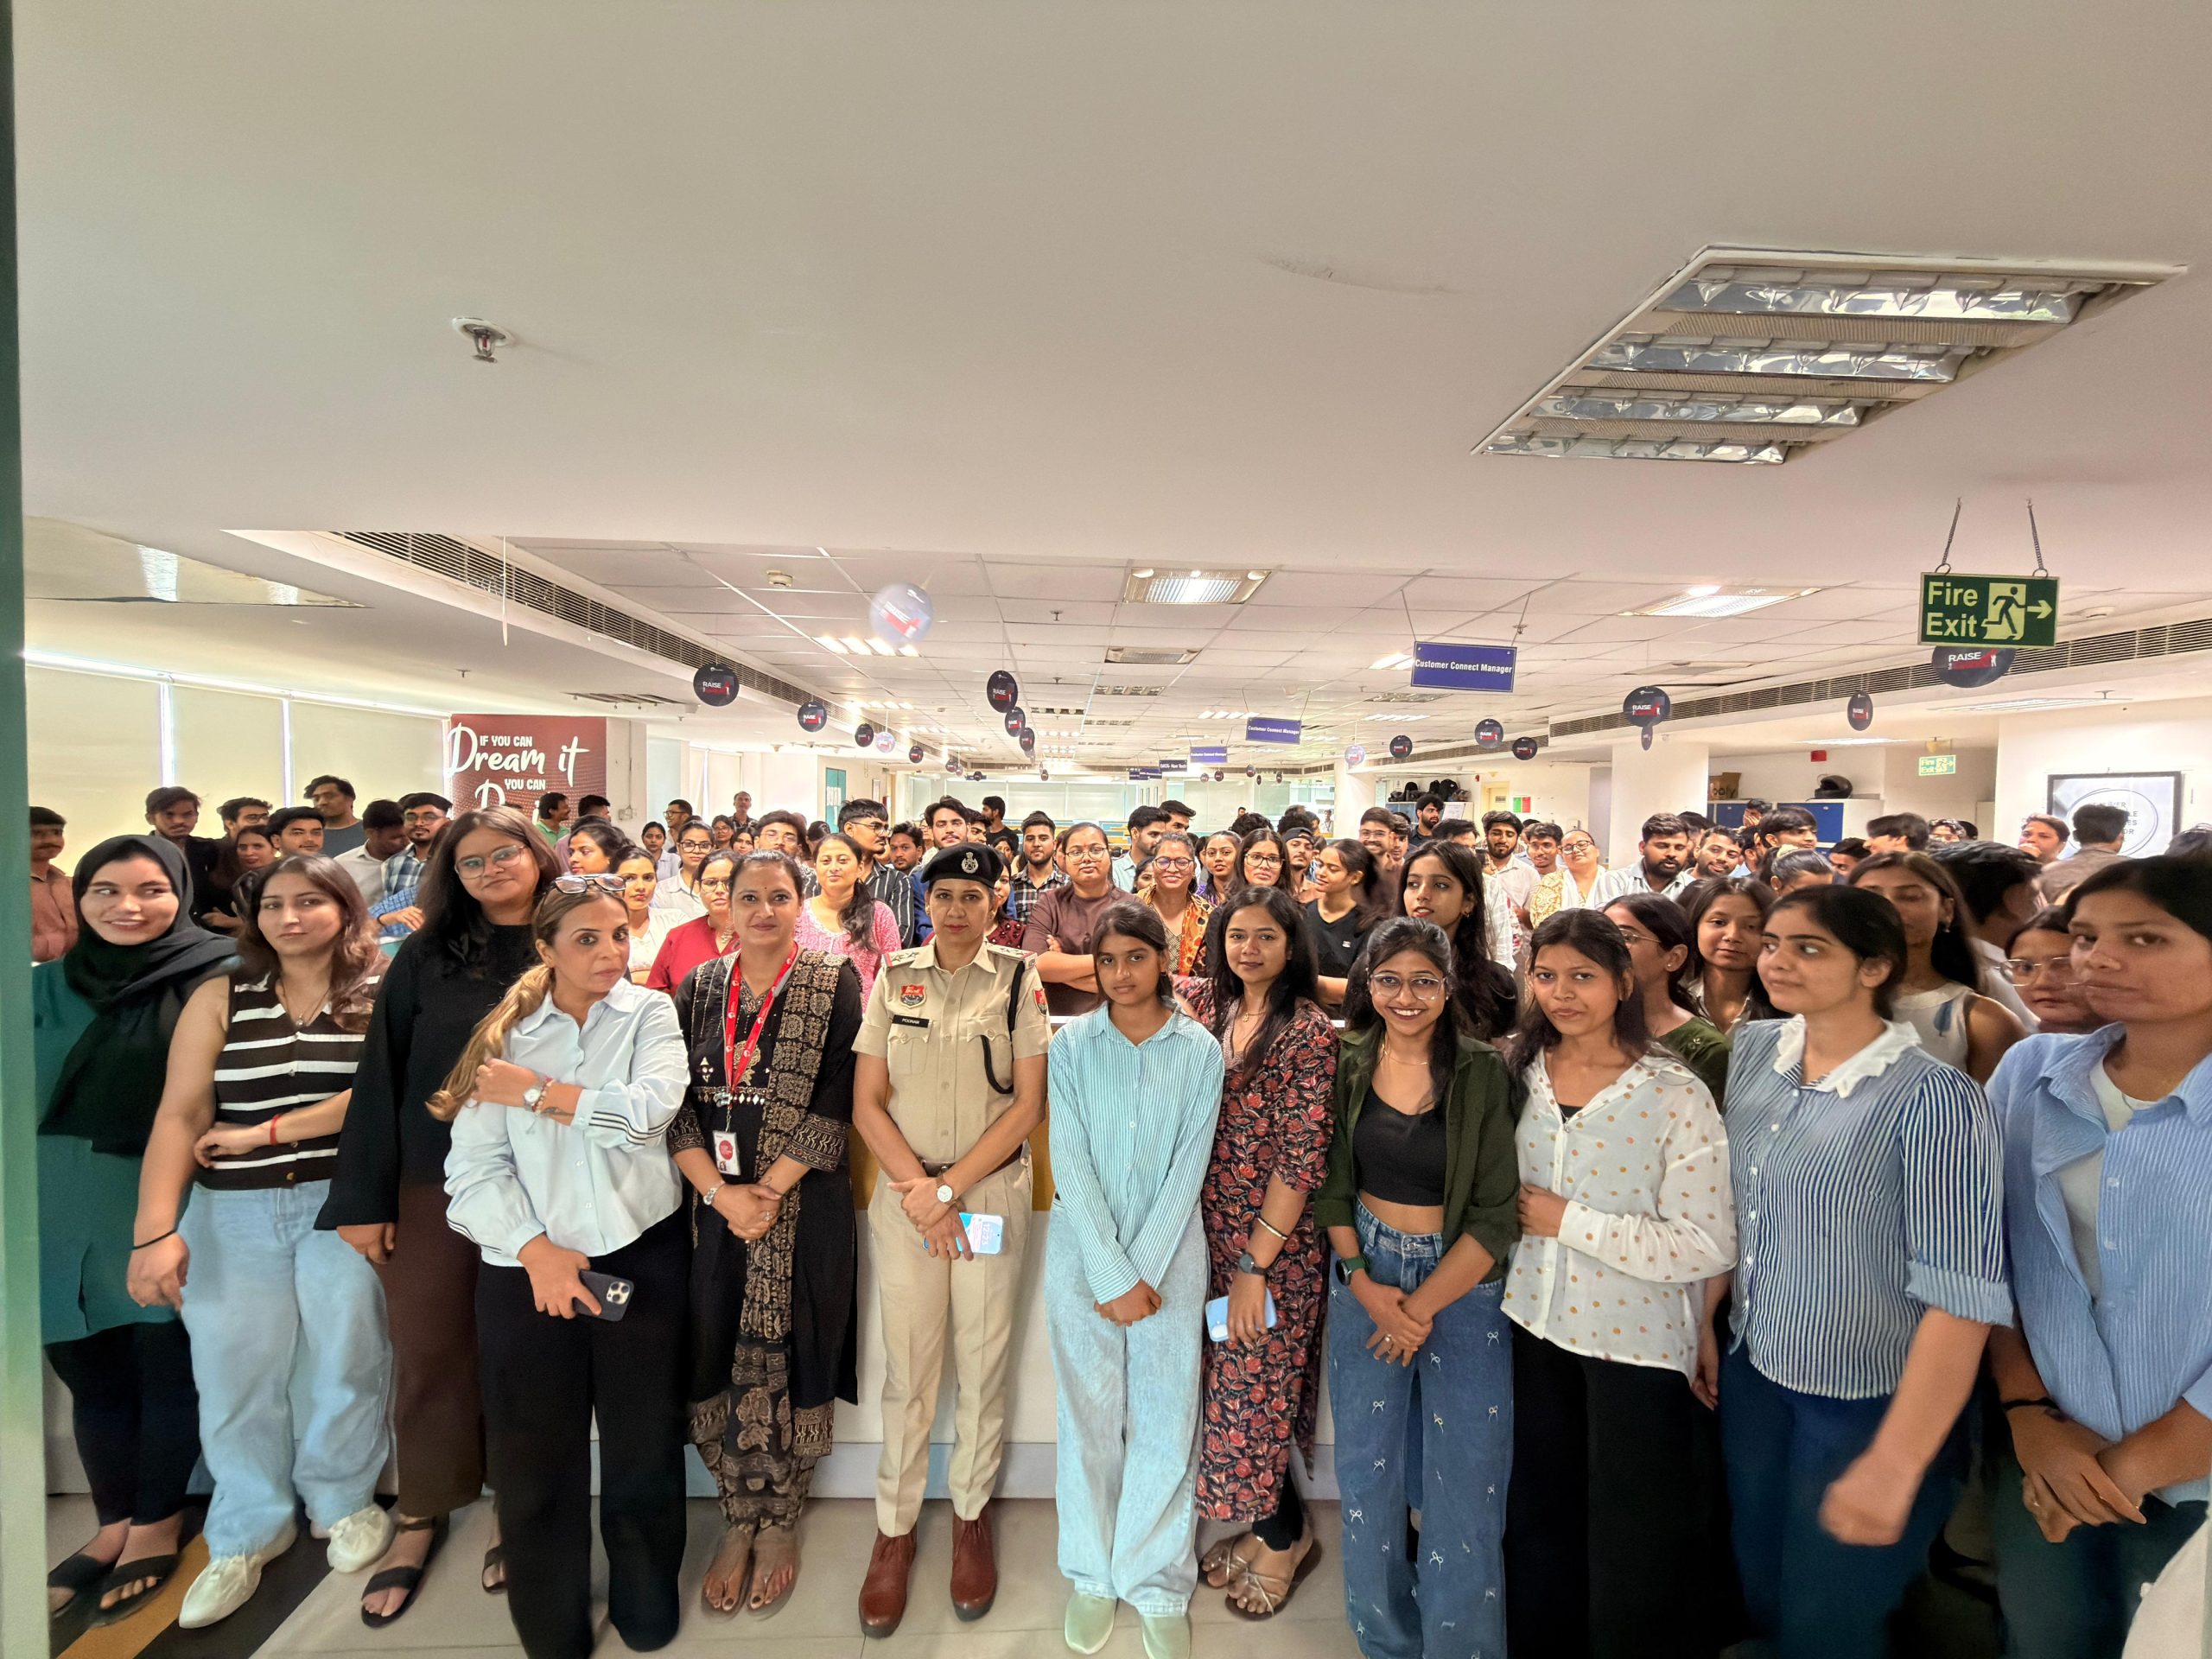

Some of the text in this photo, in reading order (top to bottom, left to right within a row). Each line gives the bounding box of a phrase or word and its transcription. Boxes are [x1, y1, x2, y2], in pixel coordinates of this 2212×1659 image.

[1928, 581, 1979, 607] Fire
[1926, 612, 1977, 638] Exit
[1948, 652, 1982, 663] RAISE
[1415, 659, 1513, 674] Customer Connect Manager
[480, 735, 533, 747] IF YOU CAN
[447, 722, 590, 787] Dream it
[505, 779, 545, 791] YOU CAN
